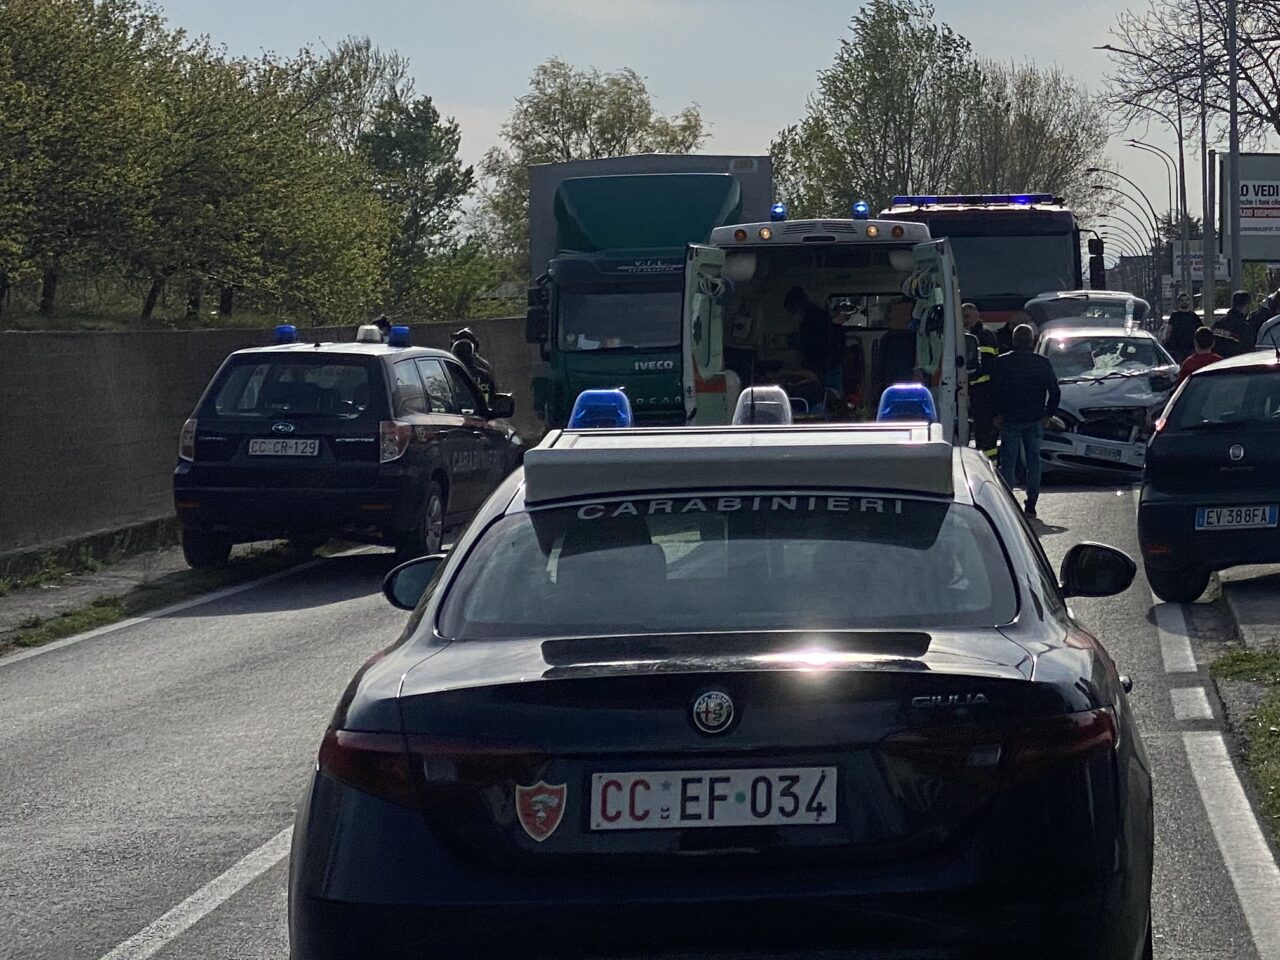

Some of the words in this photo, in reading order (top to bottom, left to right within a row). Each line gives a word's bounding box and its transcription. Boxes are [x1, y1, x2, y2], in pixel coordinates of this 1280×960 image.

[1240, 184, 1249, 197] O
[1253, 184, 1279, 197] VEDI
[634, 360, 674, 371] IVECO
[251, 441, 266, 453] CC
[293, 441, 317, 455] 129
[576, 496, 903, 520] CARABINIERI
[1206, 509, 1223, 526] EV
[1227, 507, 1267, 524] 388FA
[600, 778, 651, 823] CC
[680, 776, 732, 821] EF
[749, 772, 828, 819] 034
